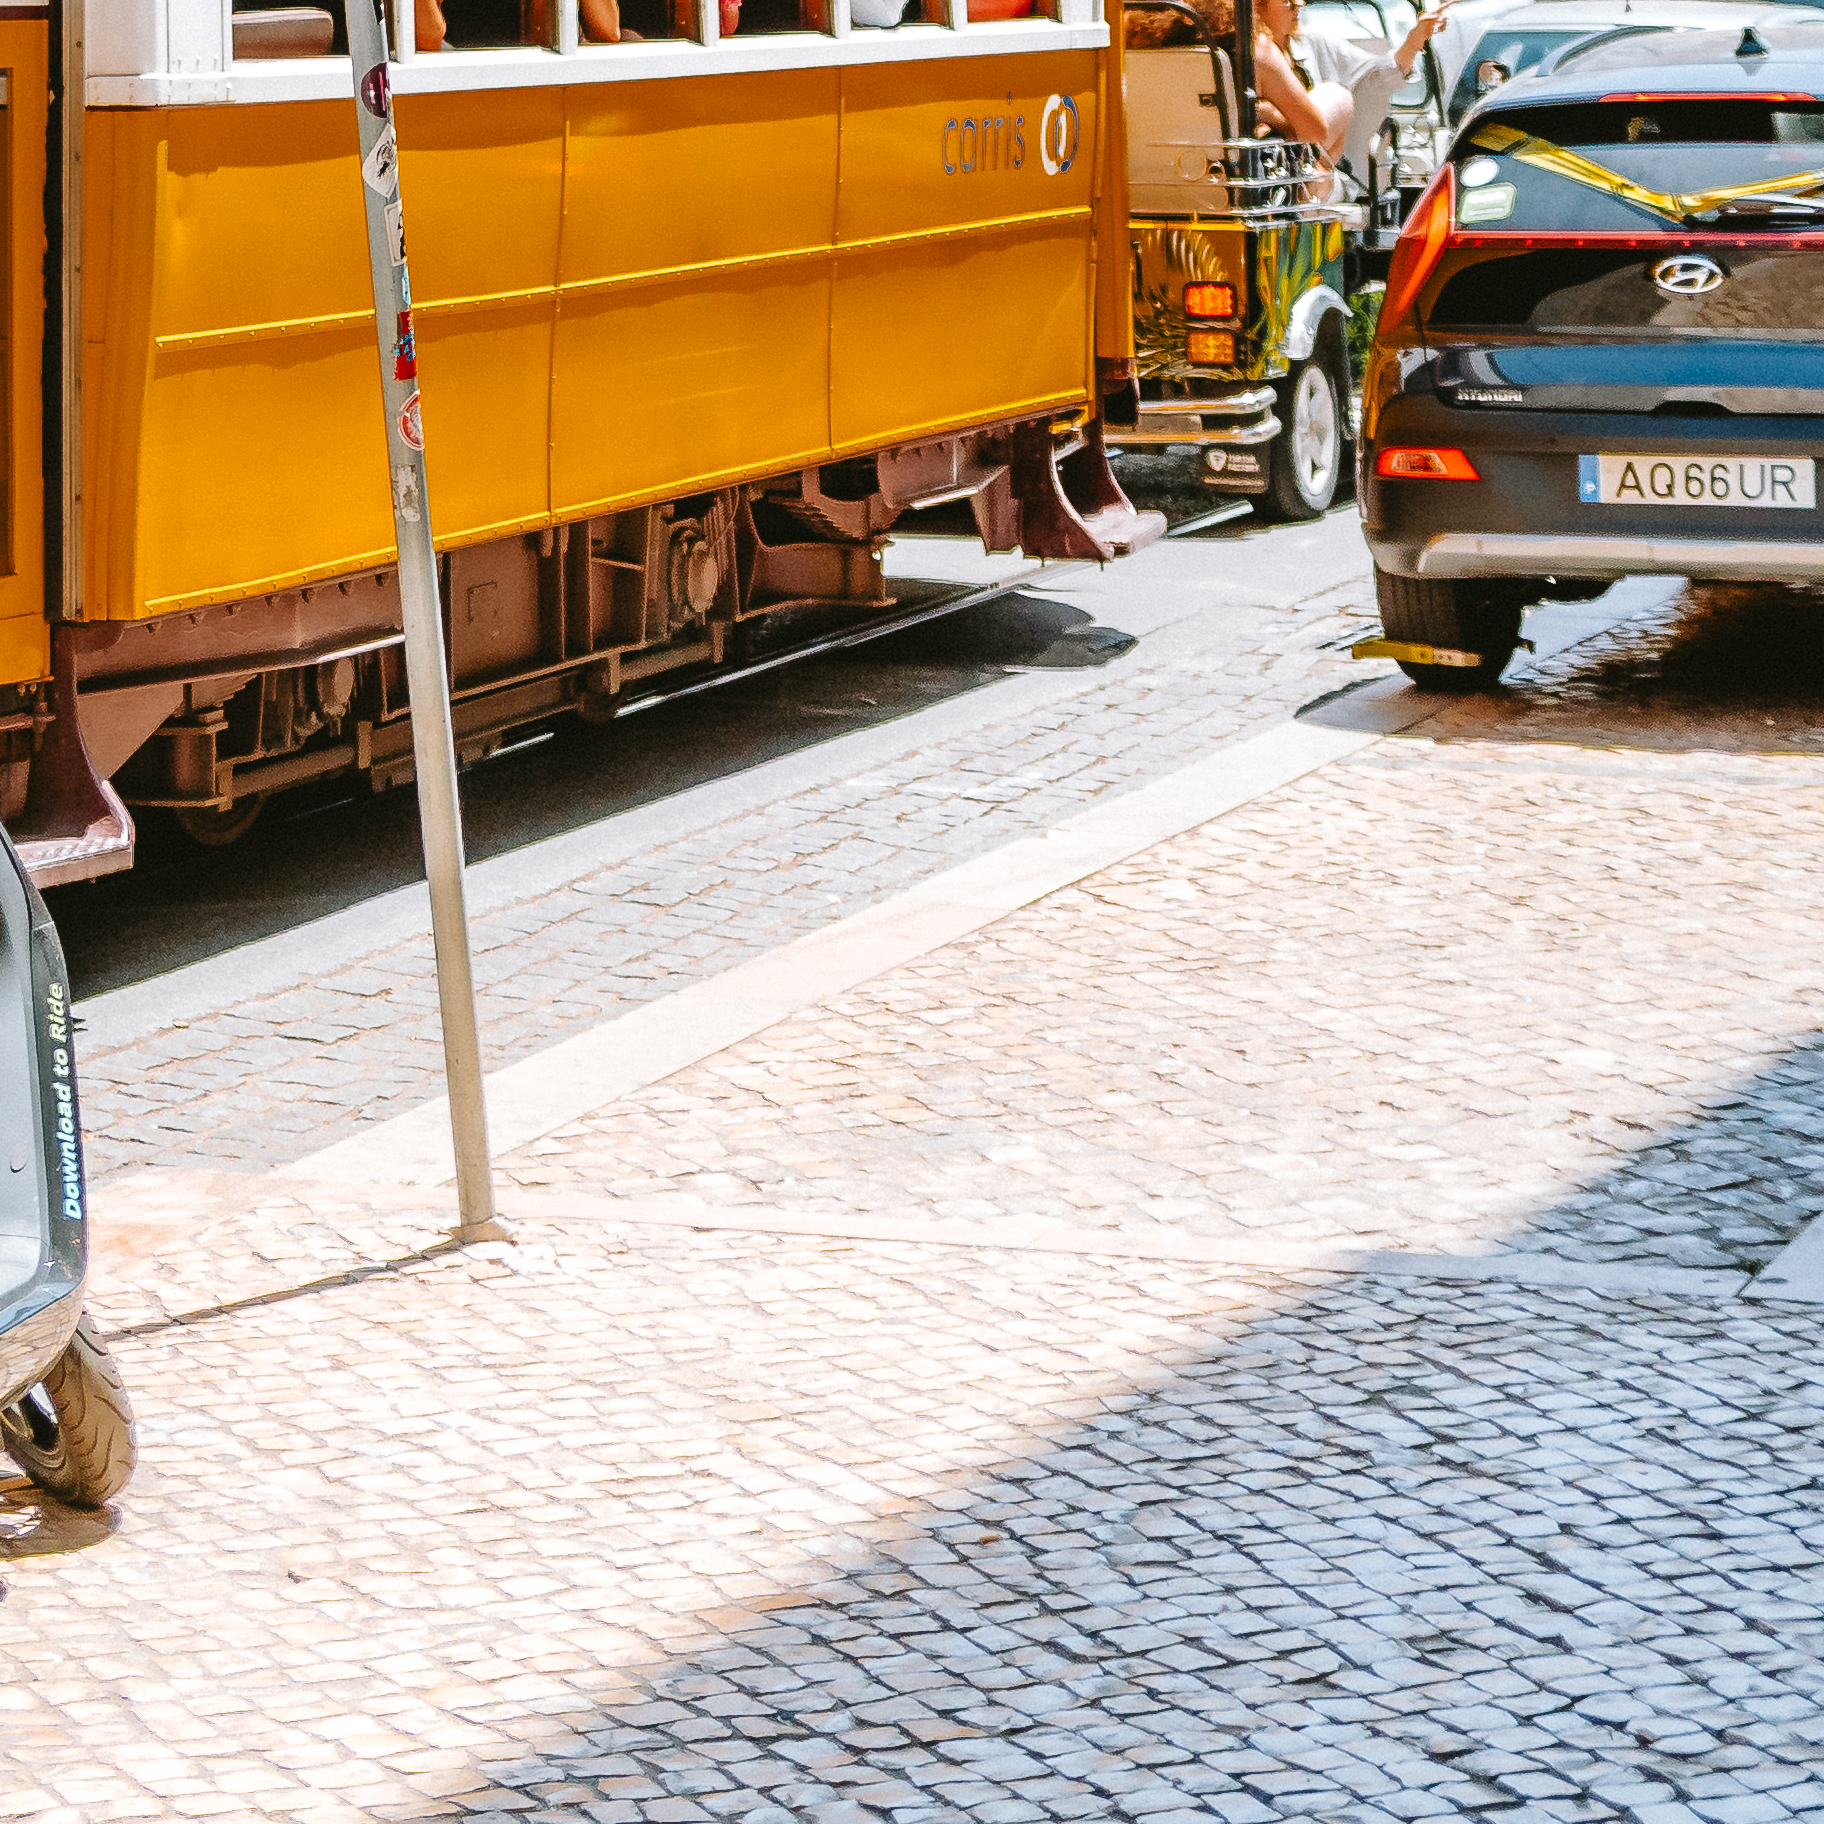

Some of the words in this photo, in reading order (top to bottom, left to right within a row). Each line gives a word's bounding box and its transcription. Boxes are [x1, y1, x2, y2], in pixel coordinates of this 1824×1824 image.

[46, 983, 68, 1043] Ride
[52, 1048, 71, 1078] to
[54, 1082, 83, 1221] Download
